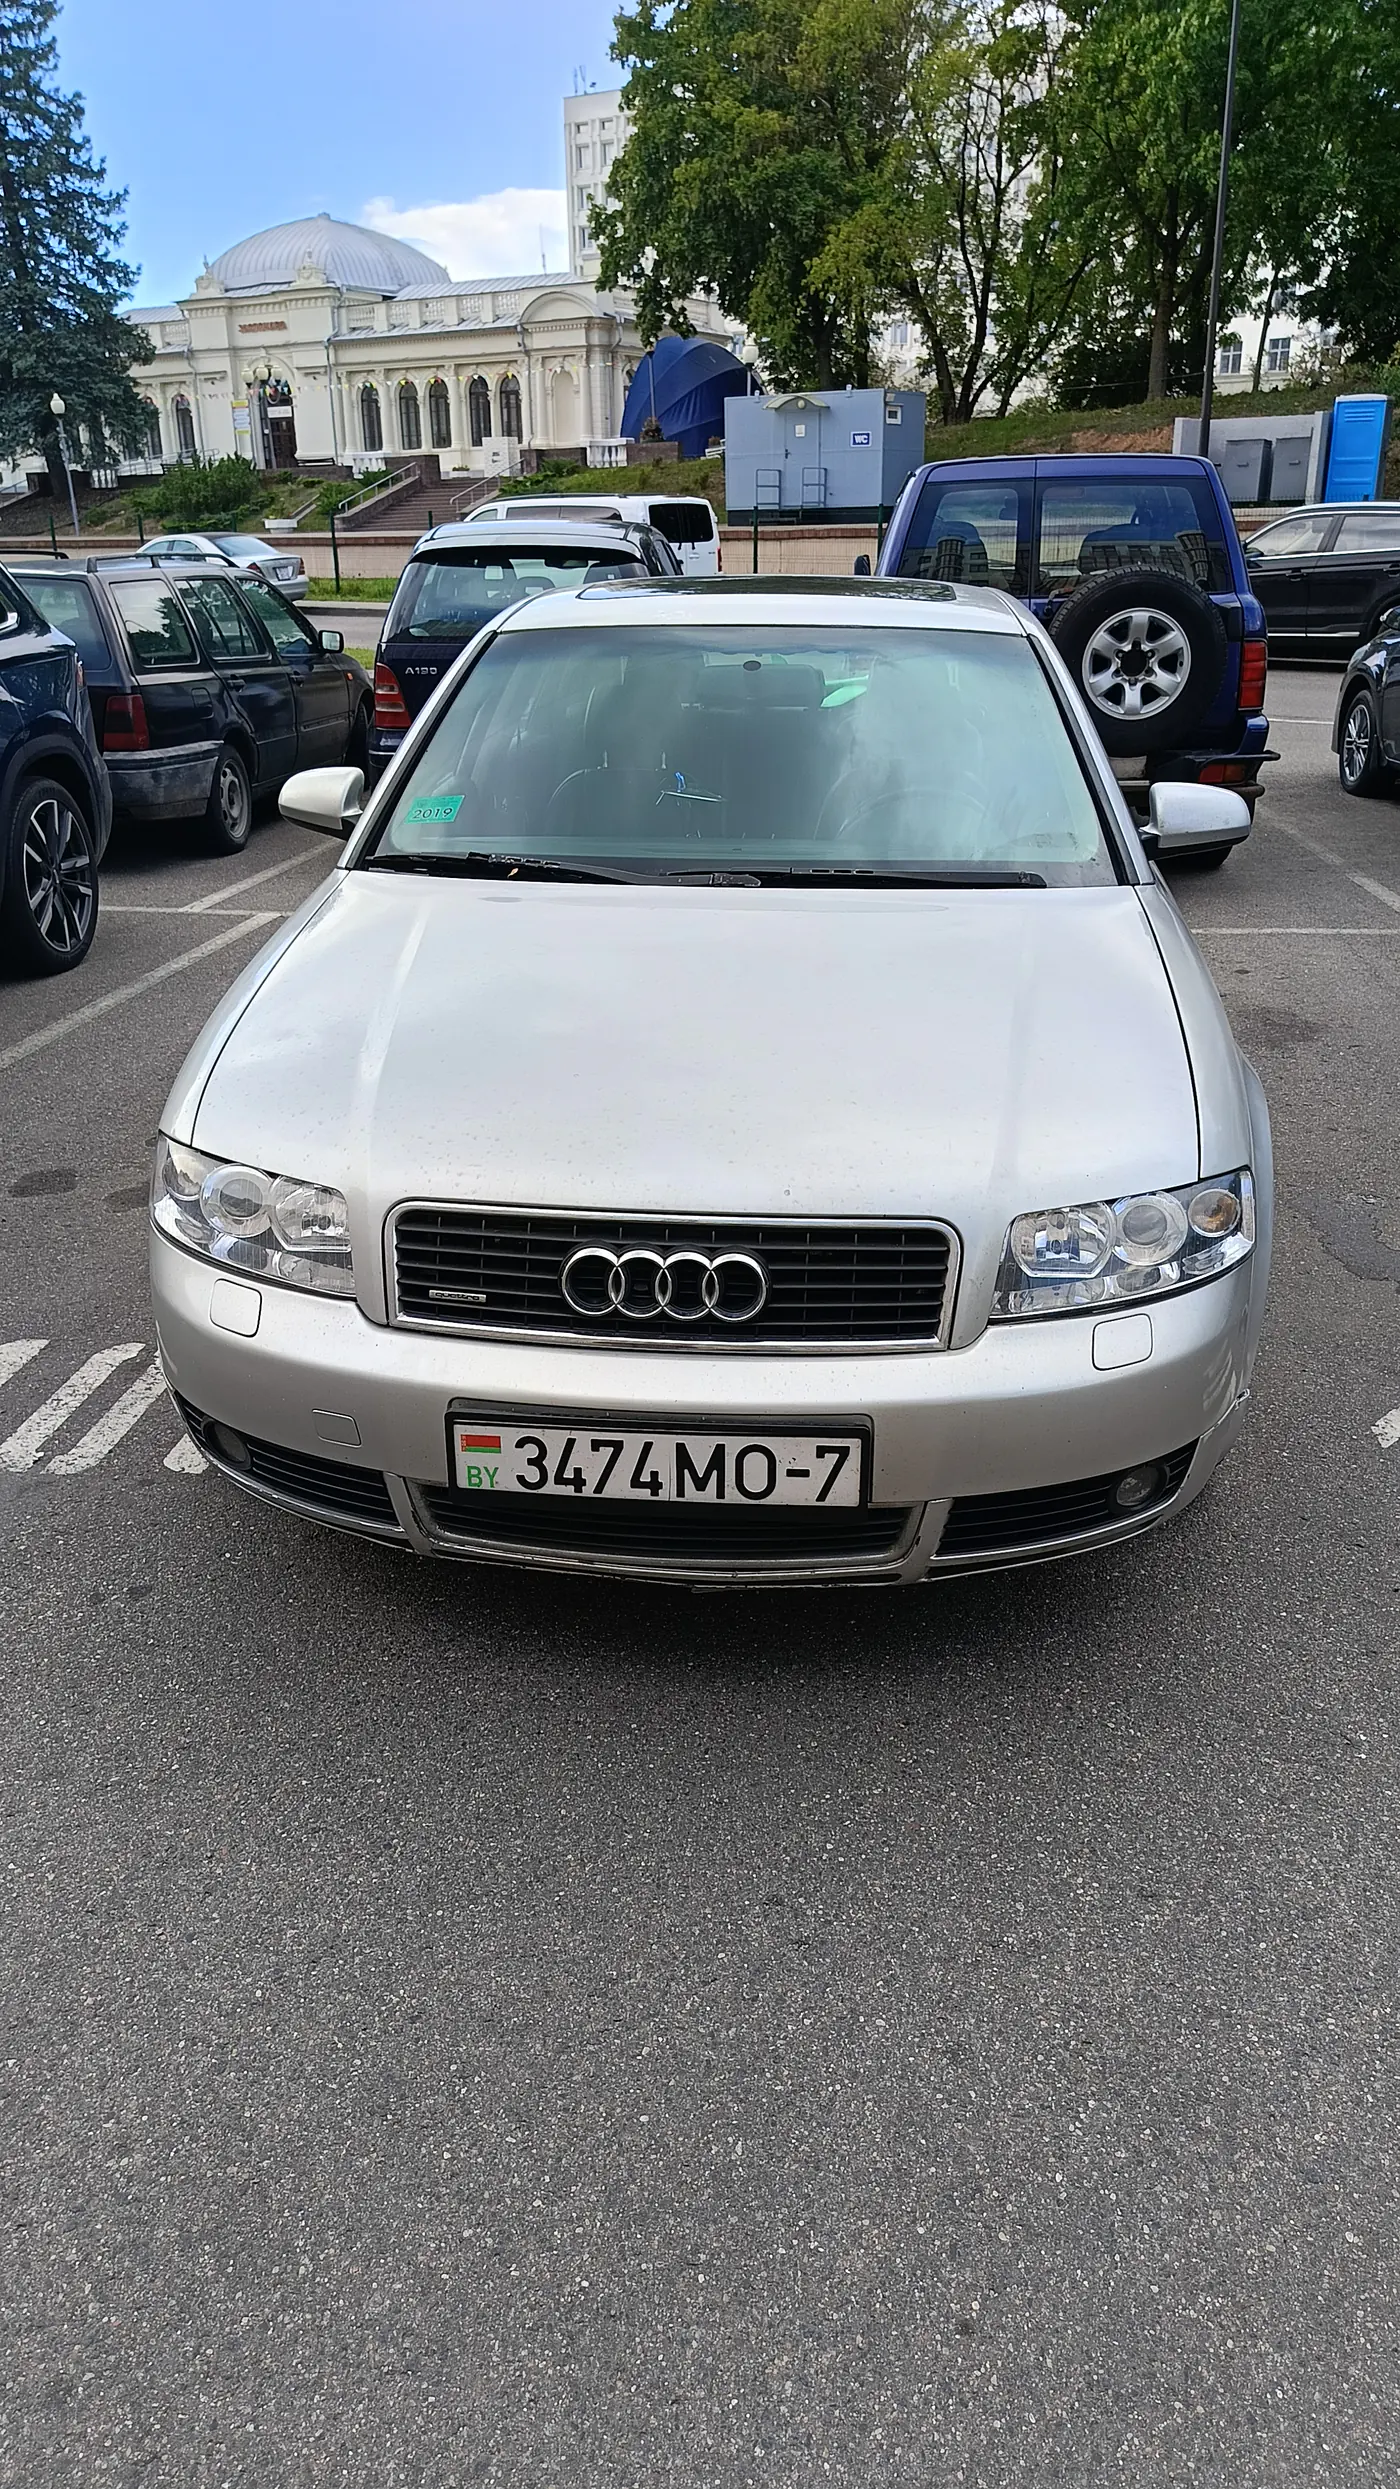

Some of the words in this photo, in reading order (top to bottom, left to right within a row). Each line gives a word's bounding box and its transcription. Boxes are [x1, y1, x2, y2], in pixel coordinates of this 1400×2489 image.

[854, 434, 869, 444] WC
[413, 808, 453, 819] 2019
[466, 1465, 499, 1489] BY
